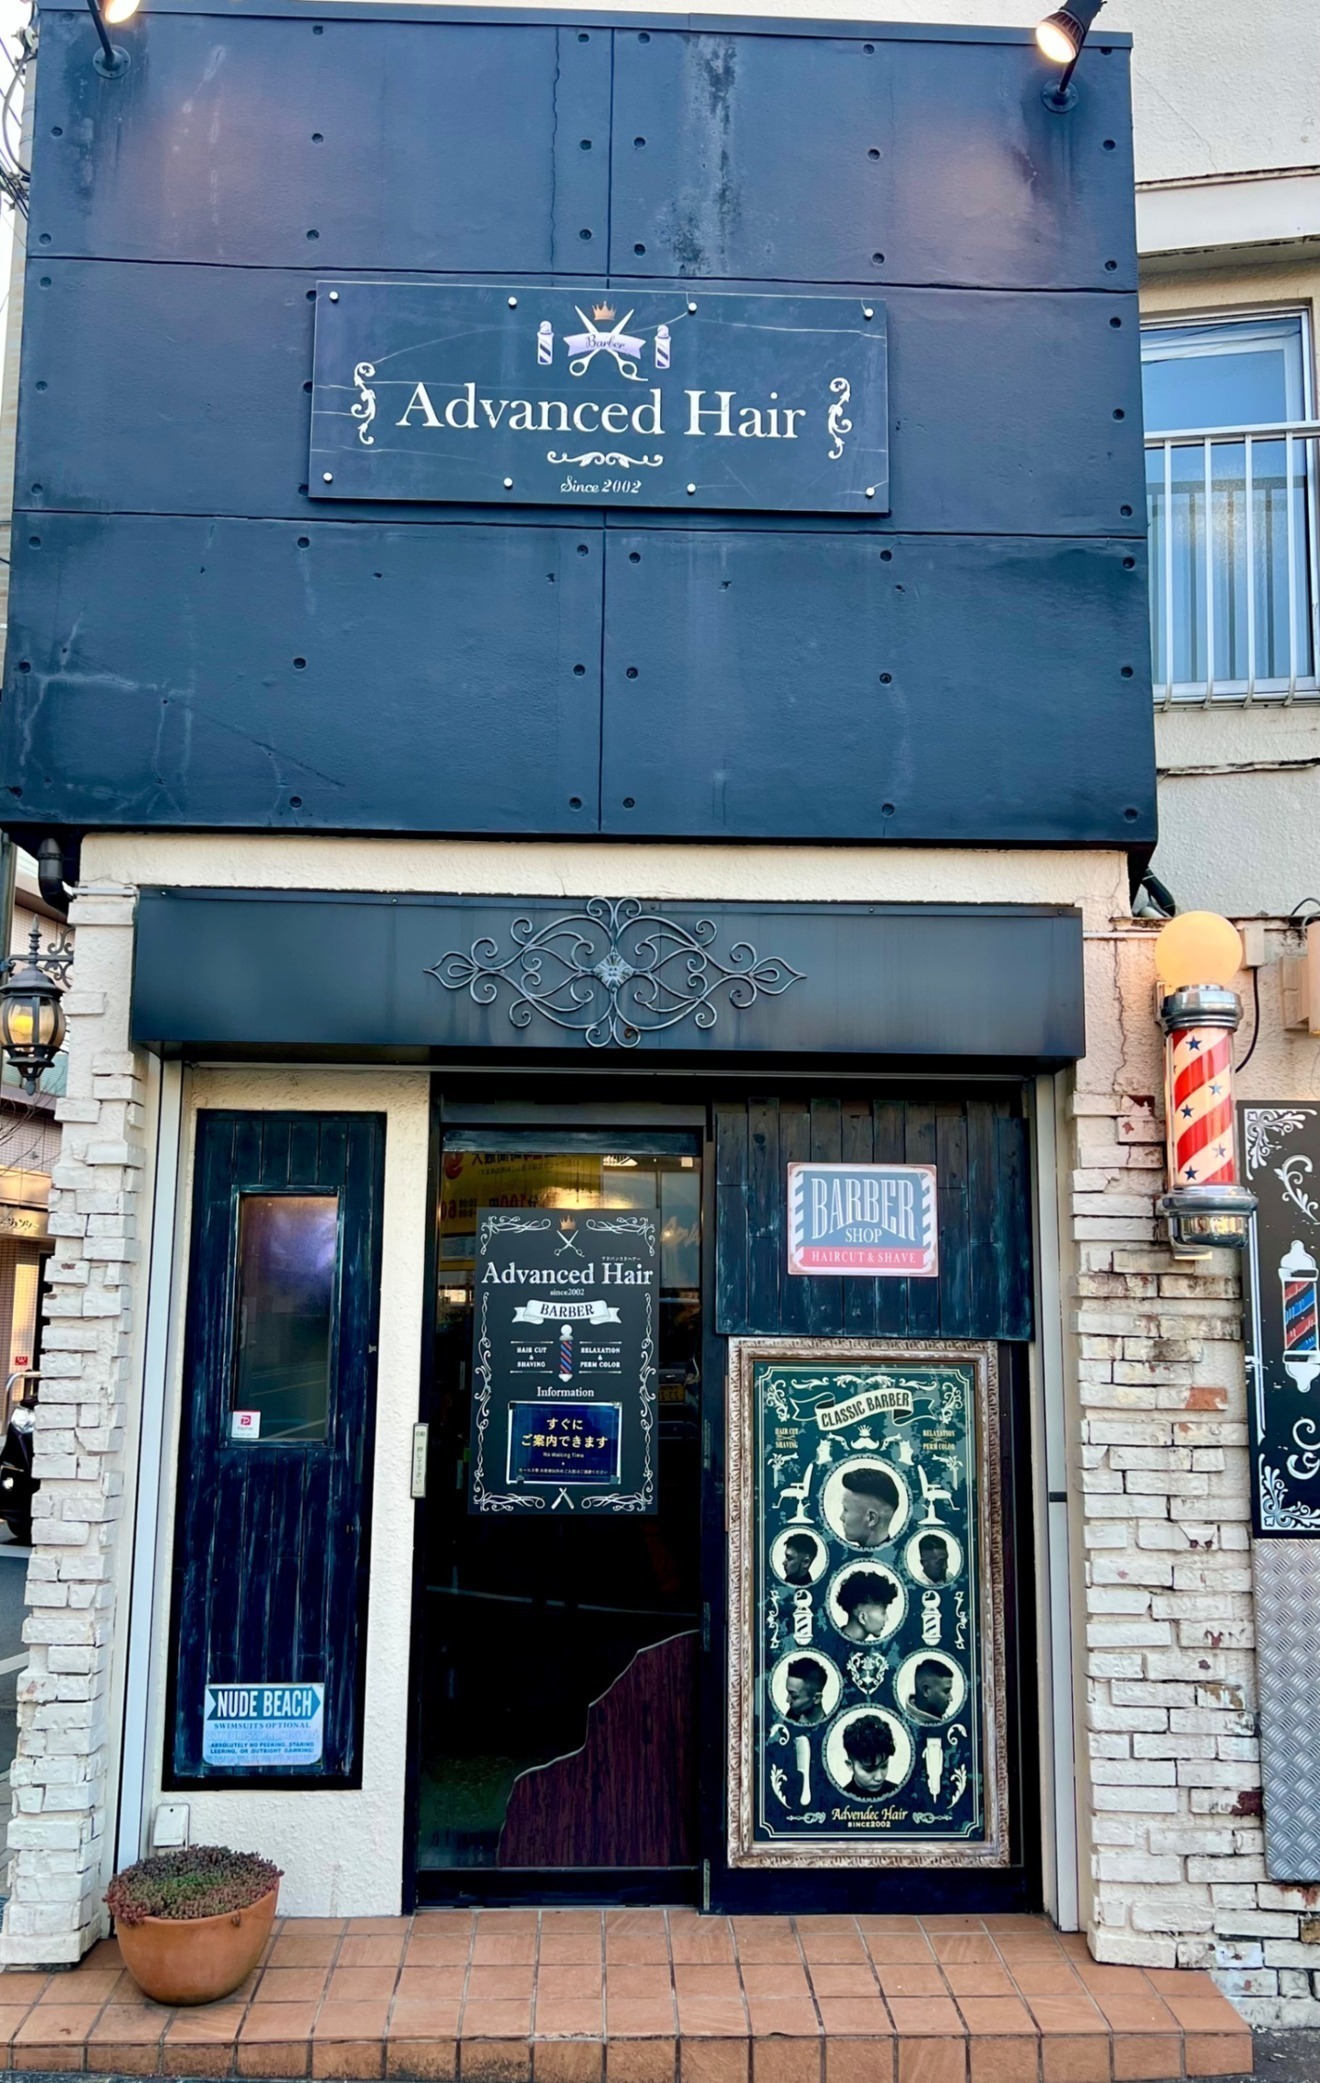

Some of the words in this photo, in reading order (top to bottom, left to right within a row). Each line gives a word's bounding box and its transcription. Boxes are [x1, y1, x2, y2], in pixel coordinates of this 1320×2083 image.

[585, 334, 625, 349] Barber
[396, 382, 665, 434] Advanced
[684, 390, 806, 438] Hair
[560, 475, 599, 493] Since
[602, 479, 642, 494] 2002
[811, 1178, 915, 1241] BARBER
[845, 1228, 882, 1243] SHOP
[811, 1251, 866, 1262] HAIRCUT
[867, 1253, 874, 1262] &
[877, 1252, 916, 1263] SHAVE
[481, 1262, 595, 1285] Advanced
[601, 1263, 653, 1285] Hair
[540, 1303, 595, 1318] BARBER
[537, 1386, 594, 1398] Information
[821, 1401, 865, 1428] CLASSIC
[866, 1392, 910, 1412] BARBER
[546, 1418, 583, 1430] すぐに
[521, 1434, 608, 1448] ご案内できます
[217, 1691, 258, 1717] NUDE
[263, 1690, 312, 1717] BEACH
[881, 1804, 908, 1820] Hair
